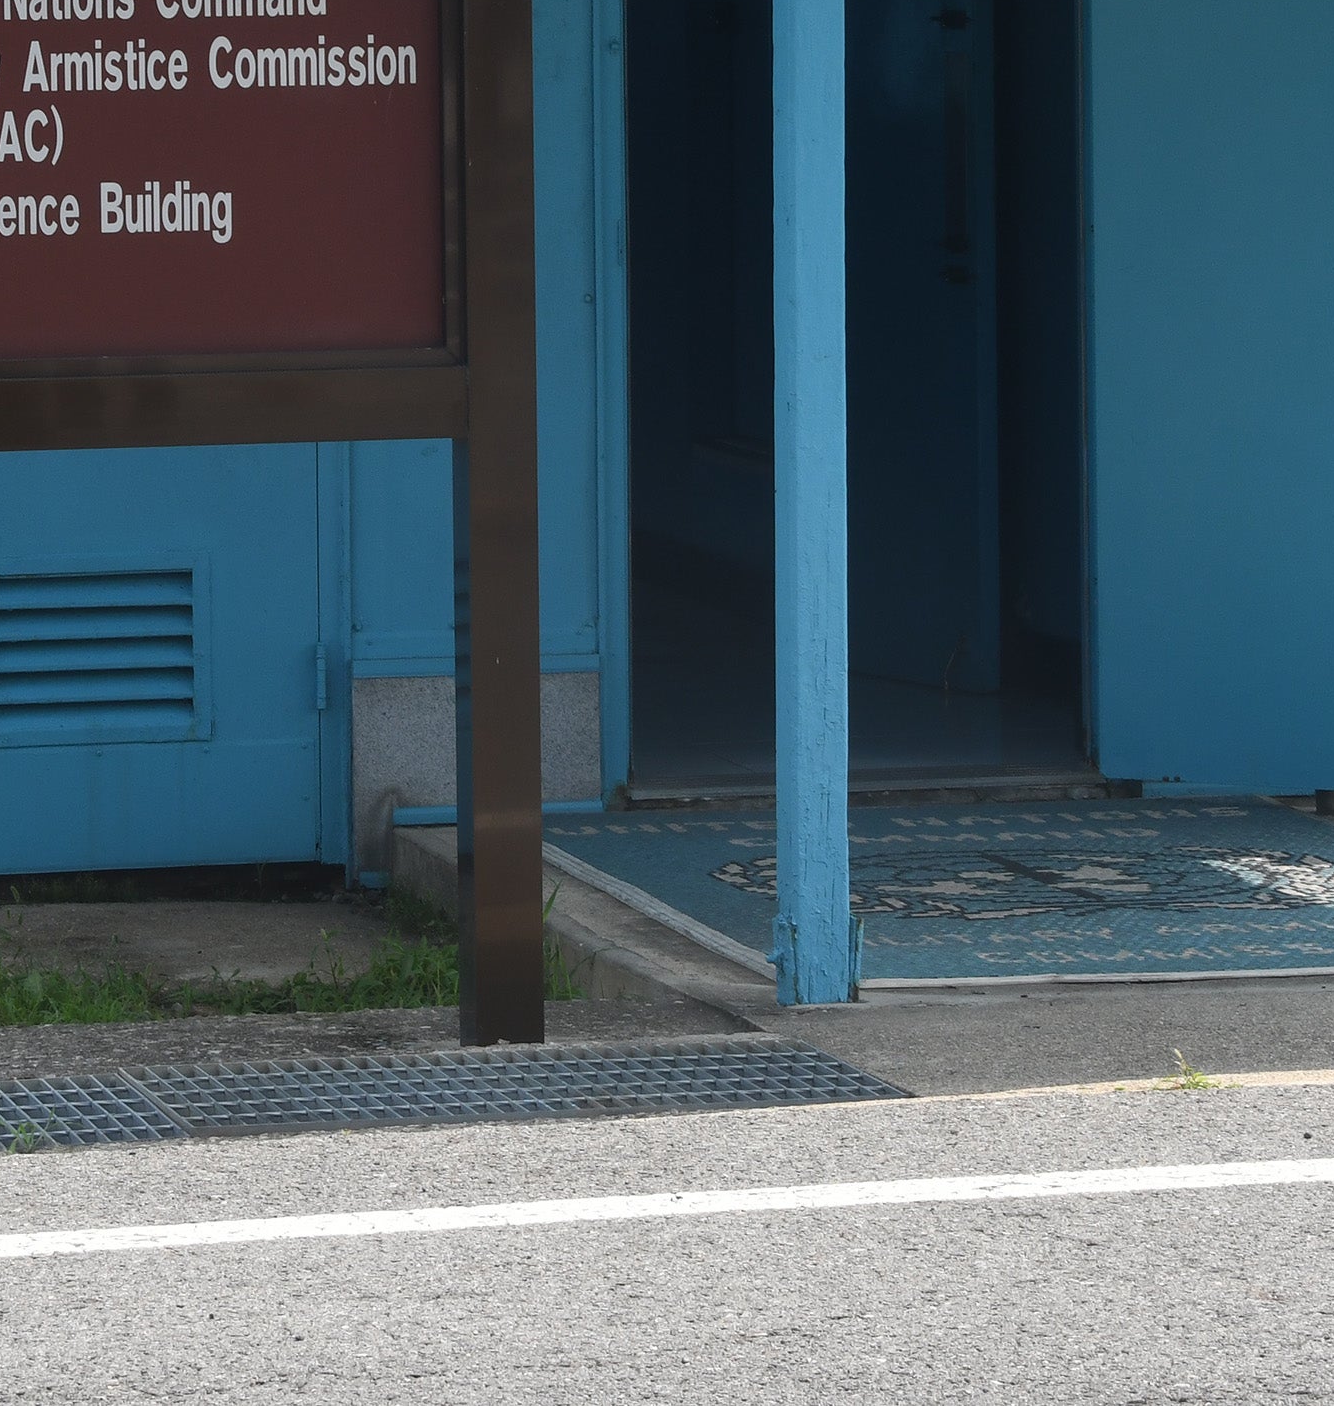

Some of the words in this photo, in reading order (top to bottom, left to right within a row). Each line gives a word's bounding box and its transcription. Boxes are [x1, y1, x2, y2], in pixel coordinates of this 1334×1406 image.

[22, 38, 188, 94] Armistice
[208, 34, 417, 89] Commission
[100, 180, 233, 244] Building
[728, 827, 1160, 848] CMMAND
[890, 806, 1249, 828] NATIONS
